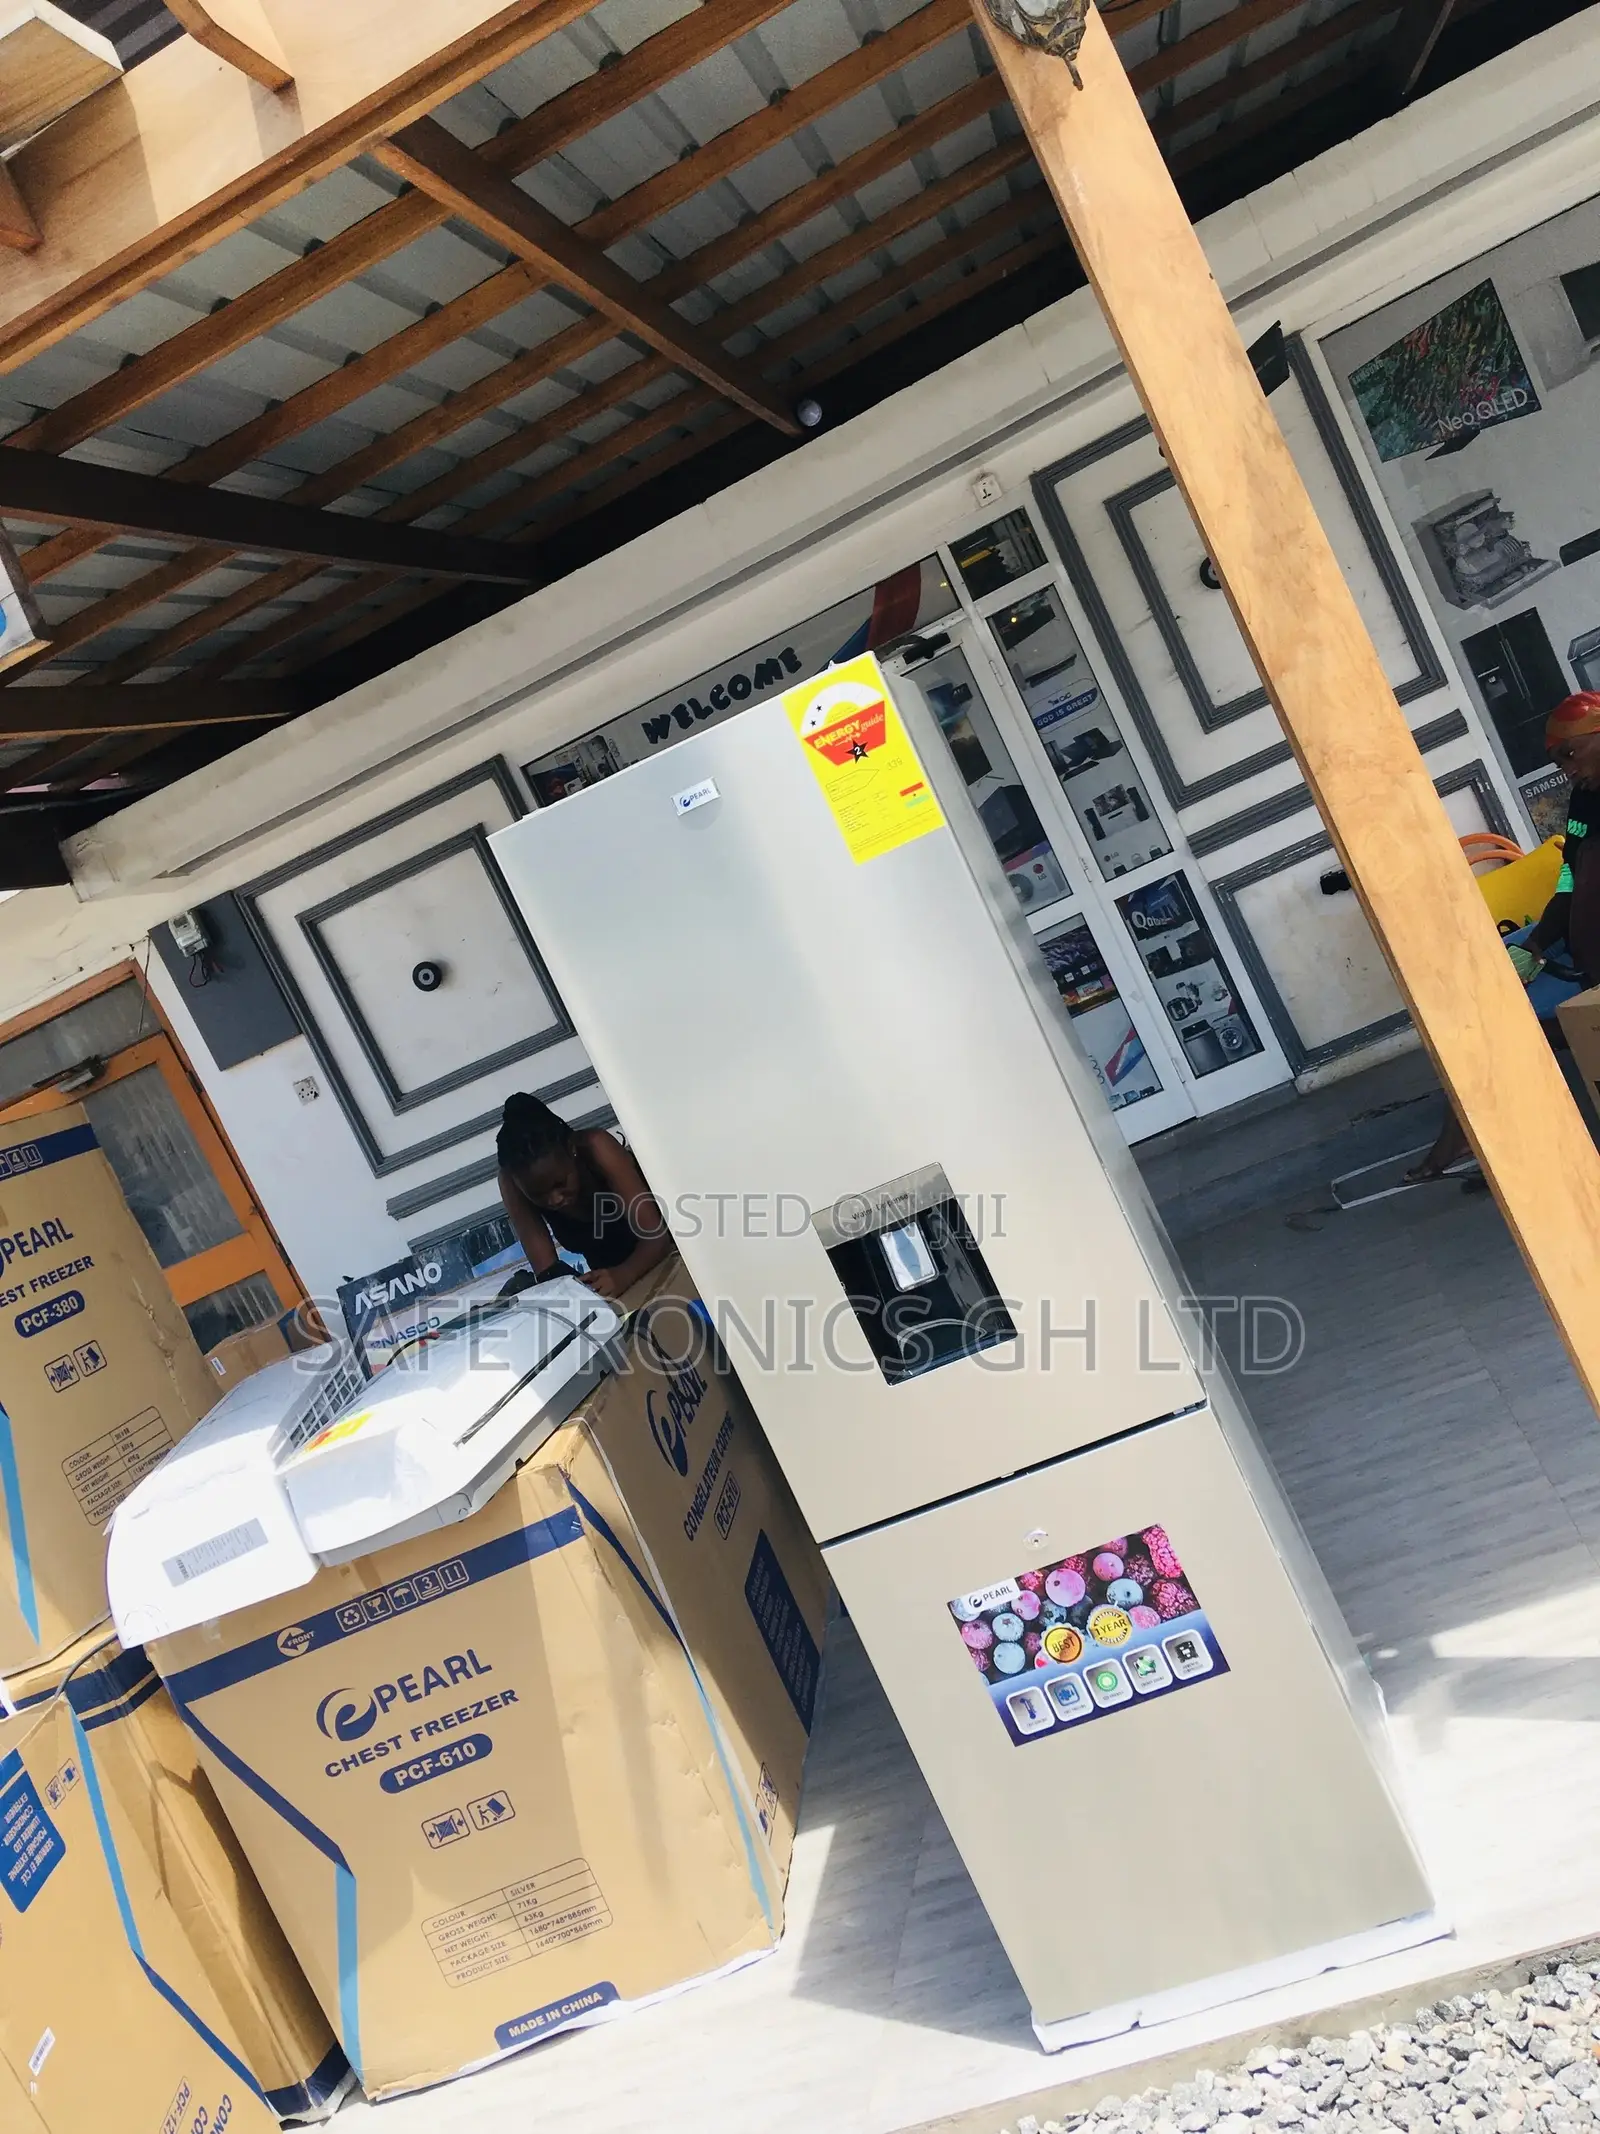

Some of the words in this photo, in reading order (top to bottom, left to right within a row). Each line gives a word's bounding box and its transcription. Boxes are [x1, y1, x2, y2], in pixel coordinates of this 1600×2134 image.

[1438, 412, 1474, 437] Neo
[1476, 387, 1528, 420] QLED
[640, 646, 803, 744] WELCOME
[1037, 713, 1055, 726] GOD
[1055, 708, 1065, 718] IS
[1066, 693, 1094, 711] GREAT
[813, 719, 862, 750] ENERGY
[860, 712, 885, 733] guide
[854, 746, 863, 756] 2
[689, 787, 713, 801] PEARL
[0, 1217, 74, 1265] PEARL
[29, 1255, 95, 1293] FREEZER
[355, 1262, 442, 1316] ASANO
[20, 1295, 79, 1334] PCF-380
[380, 1316, 441, 1349] NASCO
[982, 1585, 1013, 1602] PEARL
[287, 1631, 315, 1648] FRONT
[1052, 1636, 1075, 1653] BEST
[373, 1648, 493, 1714] PEARL
[324, 1734, 403, 1778] CHEST
[410, 1689, 520, 1742] FREEZER
[393, 1742, 476, 1786] PCF-610
[510, 1882, 536, 1897] SILVER
[438, 1926, 466, 1942] GROSS
[444, 1943, 459, 1955] NET
[450, 1947, 490, 1968] PACKAGE
[456, 1961, 493, 1981] PRODUCT
[508, 2016, 546, 2037] MADE
[546, 2009, 561, 2022] IN
[561, 1991, 604, 2016] CHINA
[190, 2106, 208, 2134] CO
[210, 2094, 232, 2134] CON
